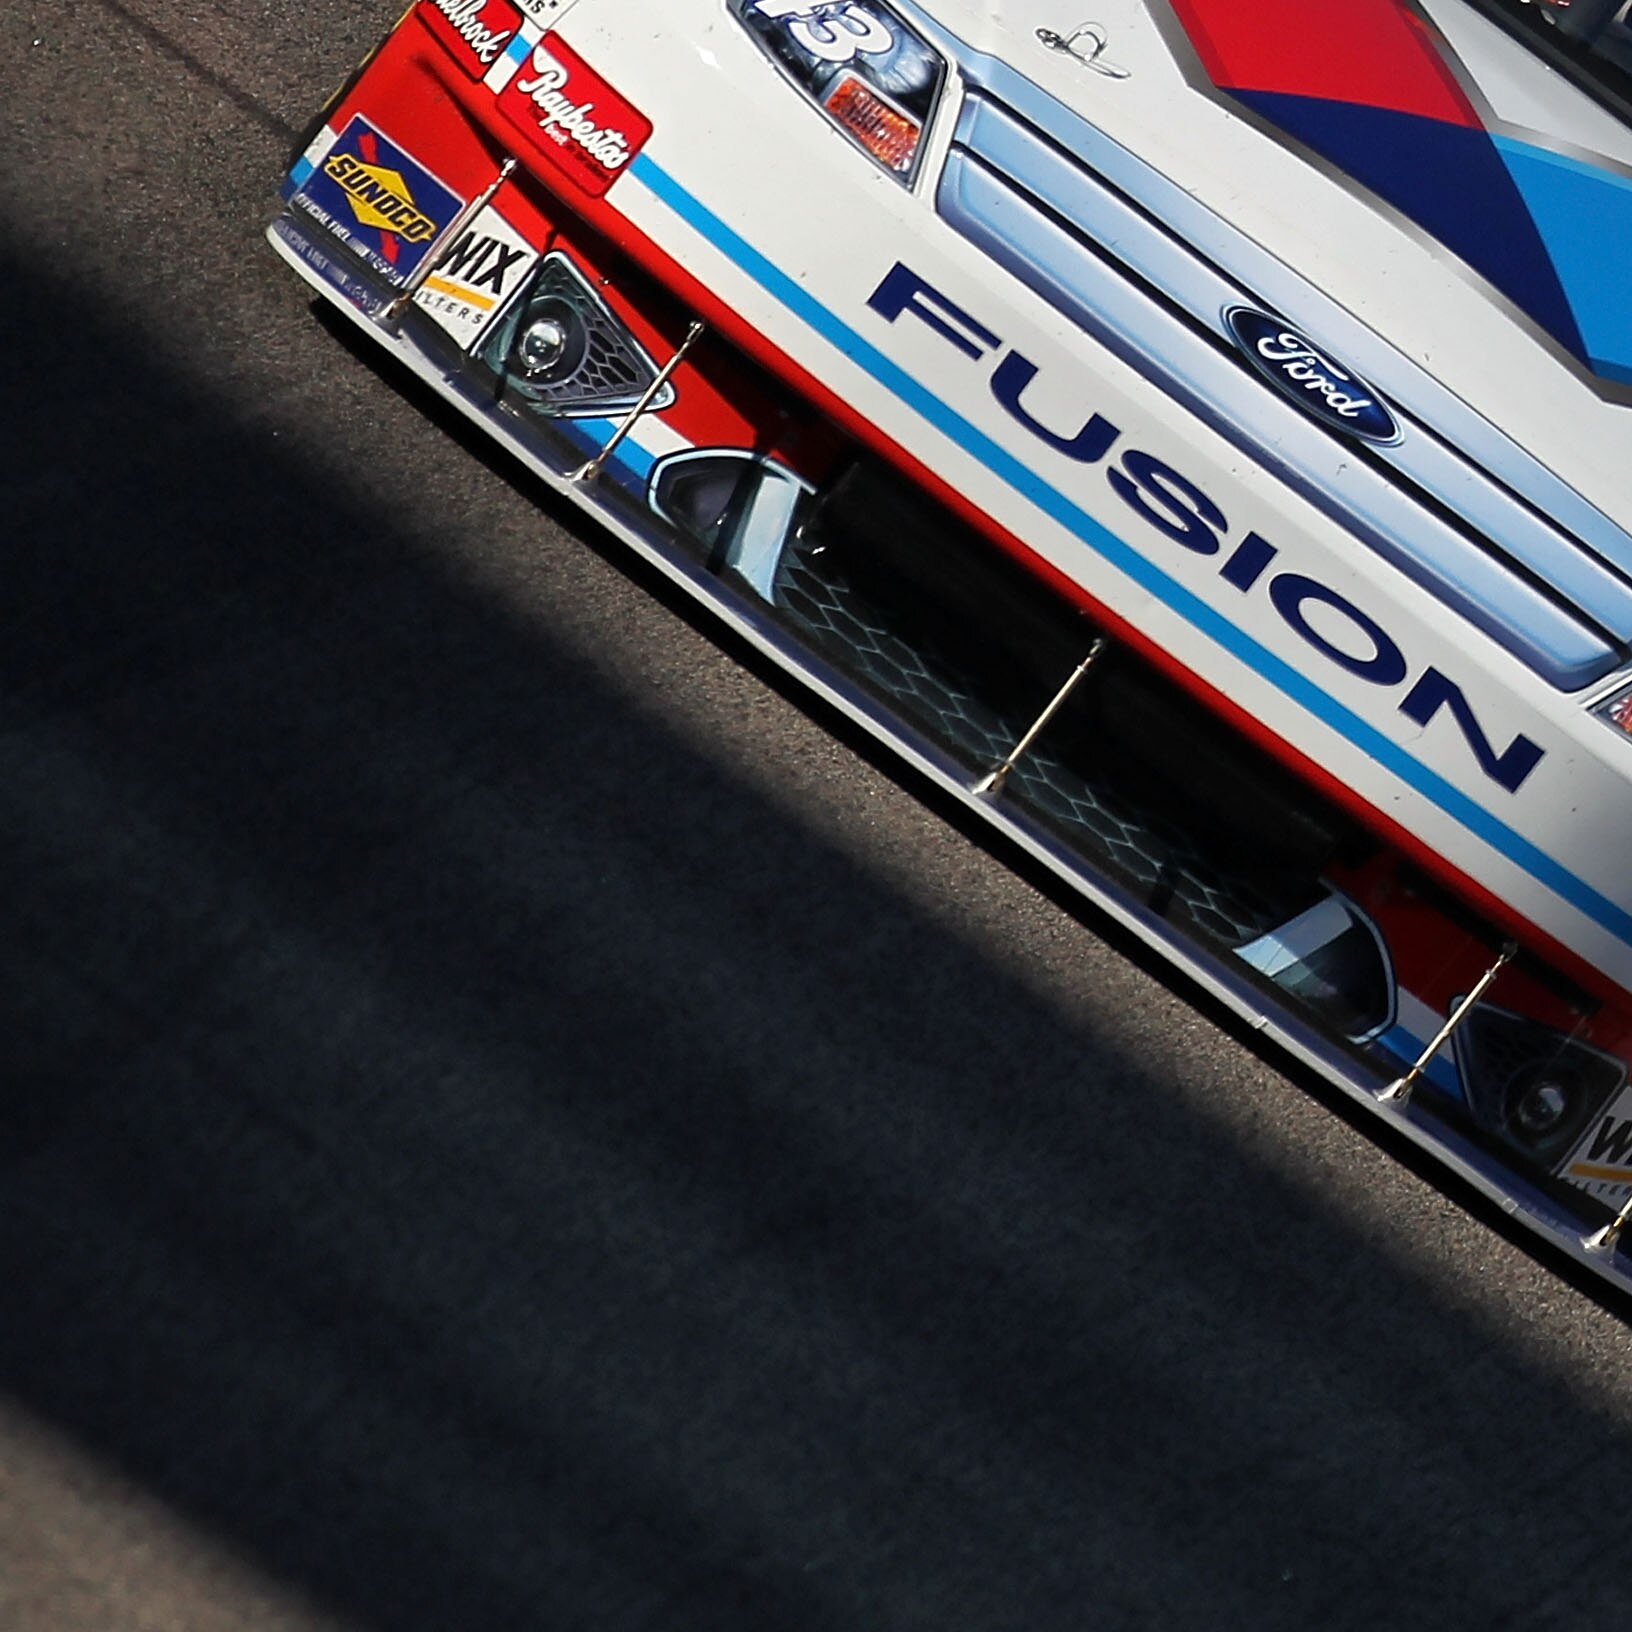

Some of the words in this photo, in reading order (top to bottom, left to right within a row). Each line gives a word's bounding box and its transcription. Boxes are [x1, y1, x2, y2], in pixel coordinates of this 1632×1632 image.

[517, 45, 629, 169] Raybestos
[328, 158, 432, 240] SUNOCO
[414, 290, 485, 325] ILTERS
[1257, 332, 1371, 417] Ford
[866, 261, 1546, 794] FUSION
